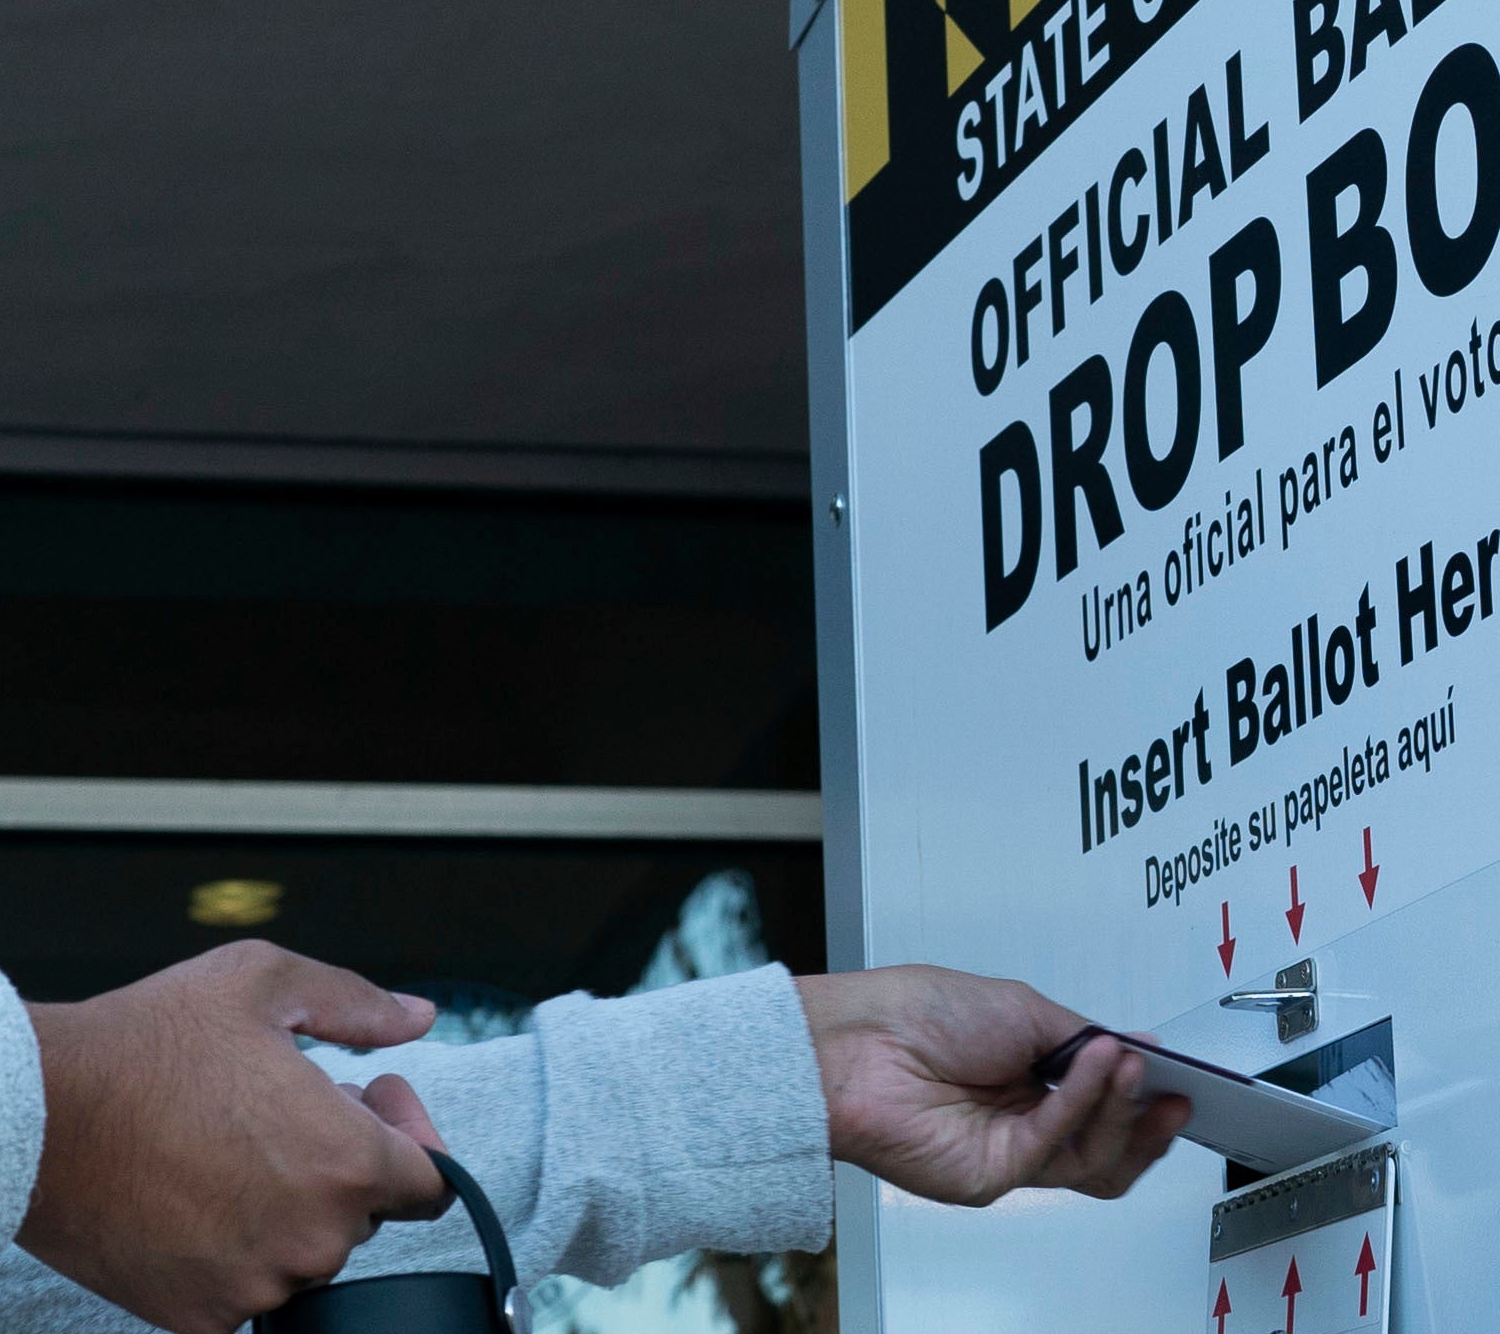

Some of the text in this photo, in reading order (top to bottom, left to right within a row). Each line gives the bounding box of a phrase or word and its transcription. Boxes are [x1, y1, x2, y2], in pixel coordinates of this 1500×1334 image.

[971, 51, 1270, 395] OFFICIAL
[980, 217, 1281, 634] DROP
[1082, 571, 1152, 662] Urna
[1165, 469, 1264, 606] oficial
[1280, 426, 1358, 548] para
[1373, 367, 1405, 464] el
[1079, 687, 1212, 853] Insert
[1227, 581, 1379, 766] Ballot
[1146, 688, 1454, 908] Deposite su papeleta aquí
